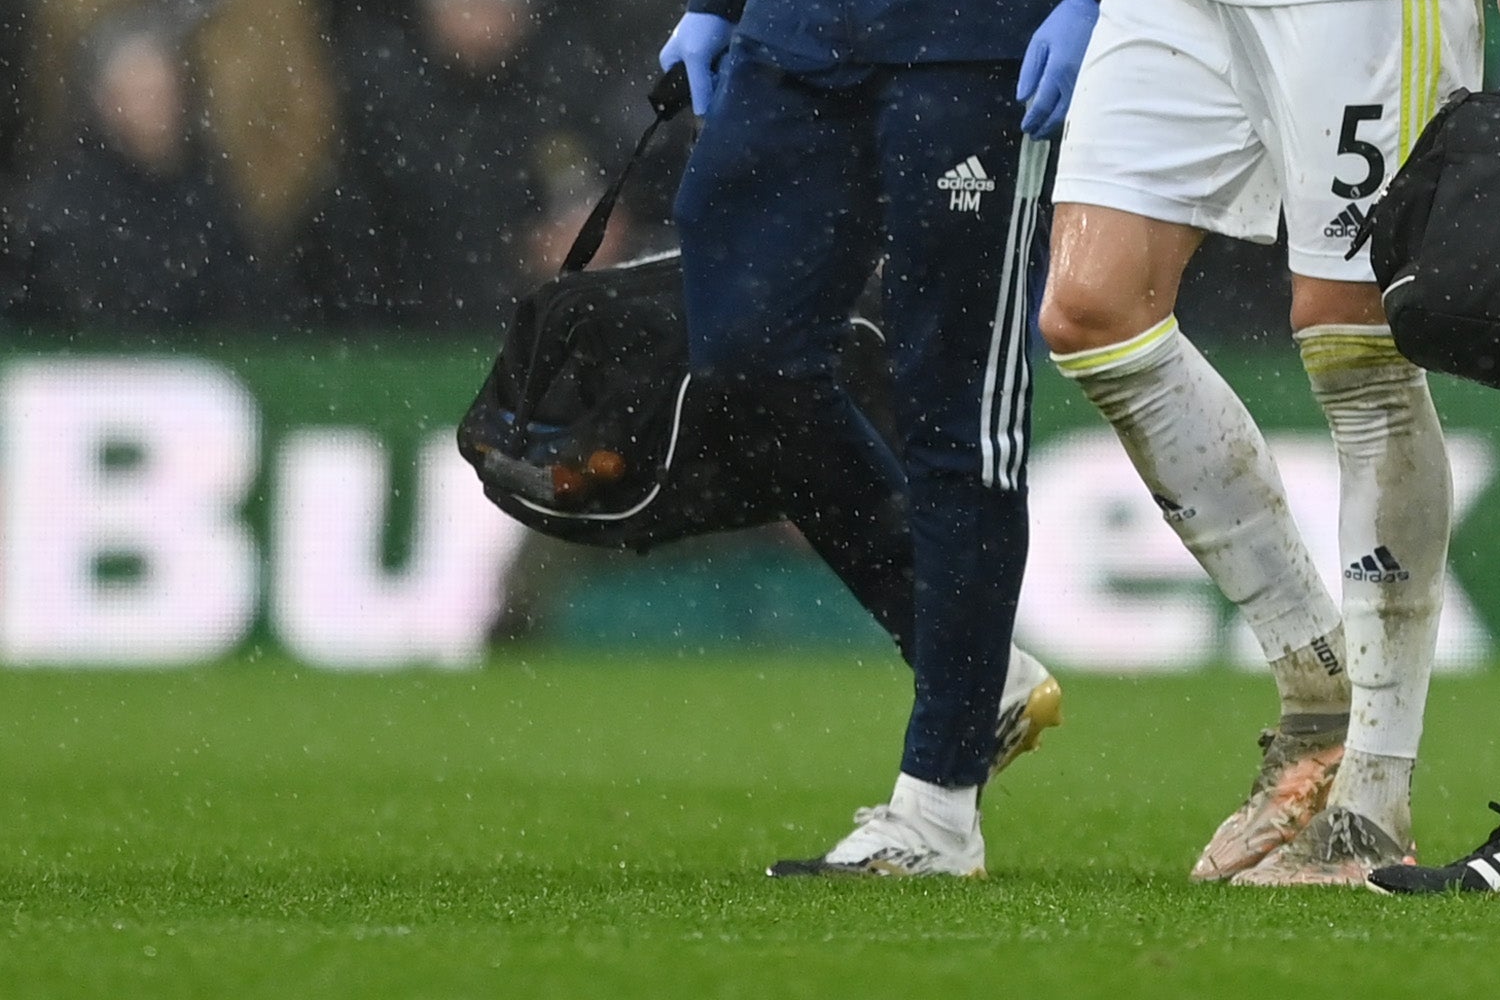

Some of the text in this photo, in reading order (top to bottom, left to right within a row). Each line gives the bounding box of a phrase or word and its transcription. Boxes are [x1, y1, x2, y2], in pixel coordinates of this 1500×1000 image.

[1331, 104, 1385, 200] 5
[937, 177, 995, 192] adidas
[949, 190, 981, 212] HM
[1344, 568, 1410, 583] adidas
